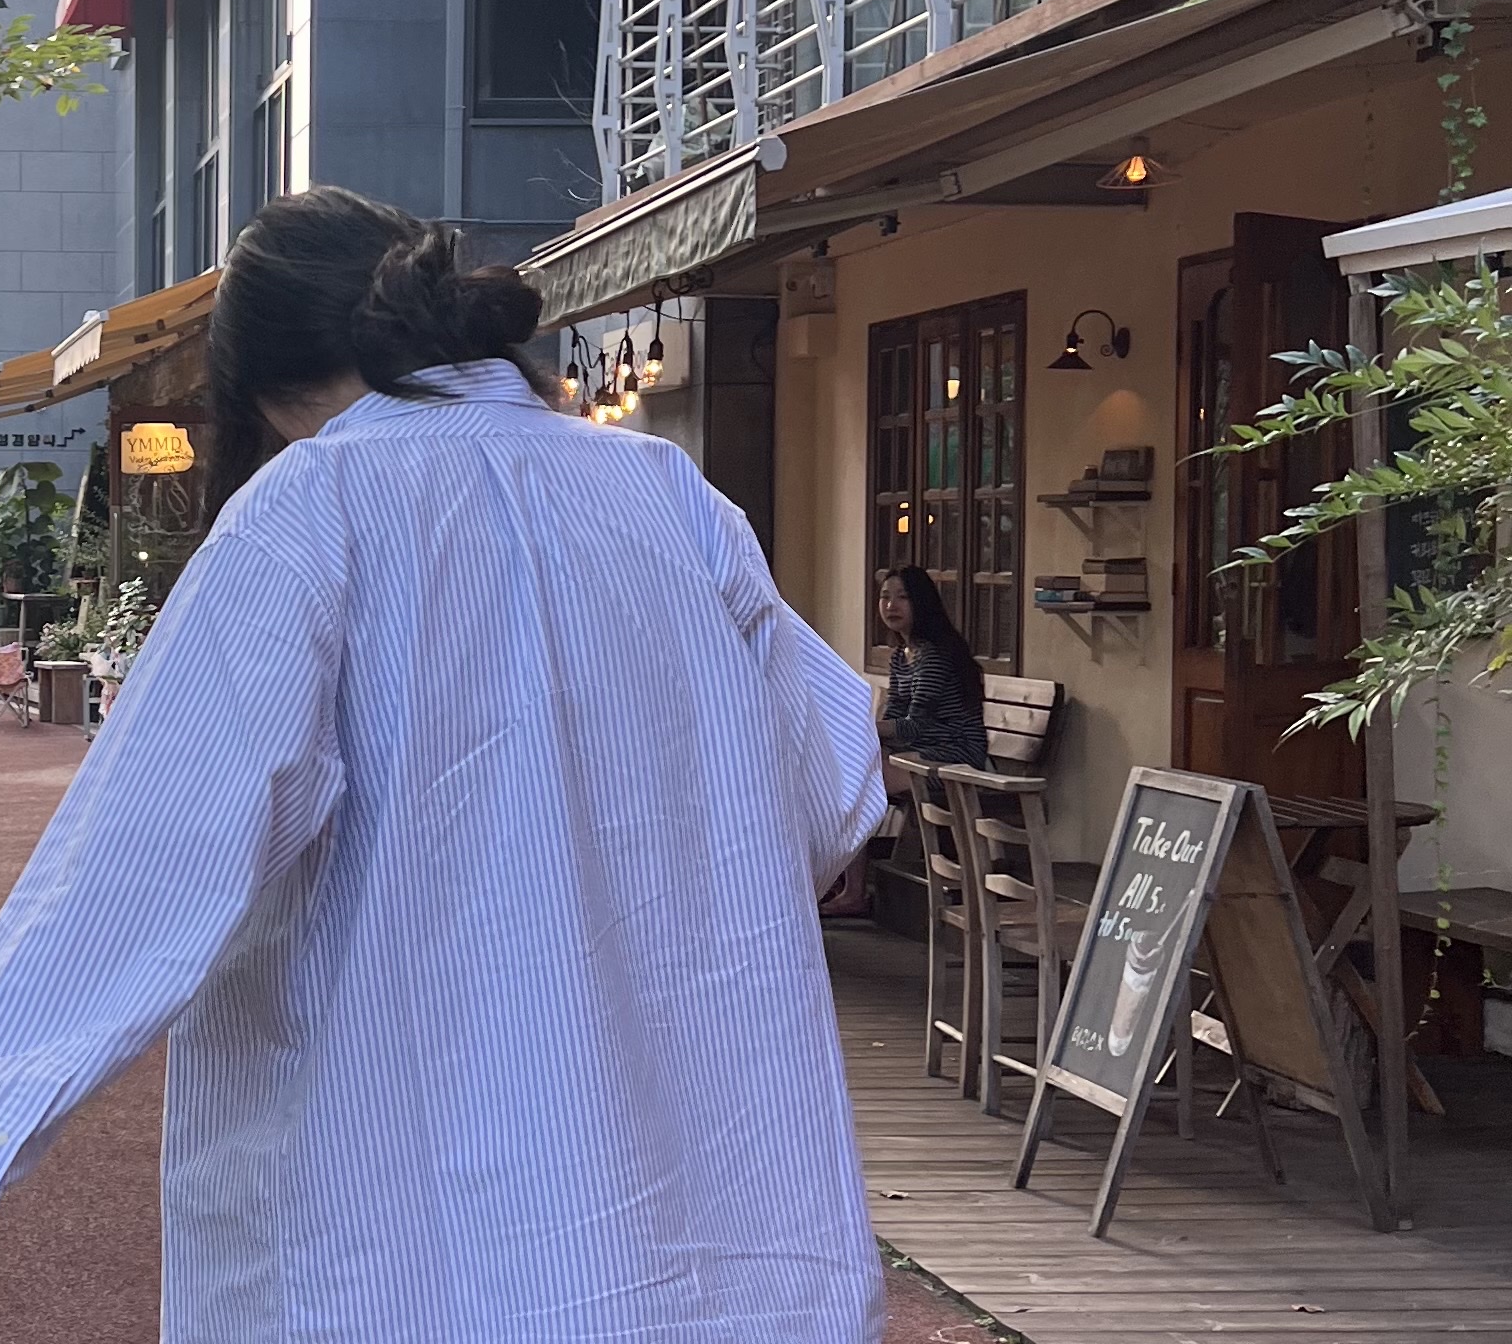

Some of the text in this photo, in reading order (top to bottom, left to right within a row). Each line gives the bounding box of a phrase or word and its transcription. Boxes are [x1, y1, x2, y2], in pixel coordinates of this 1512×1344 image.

[127, 436, 182, 453] YMMD
[1132, 816, 1204, 864] Take Out
[1118, 872, 1154, 910] All
